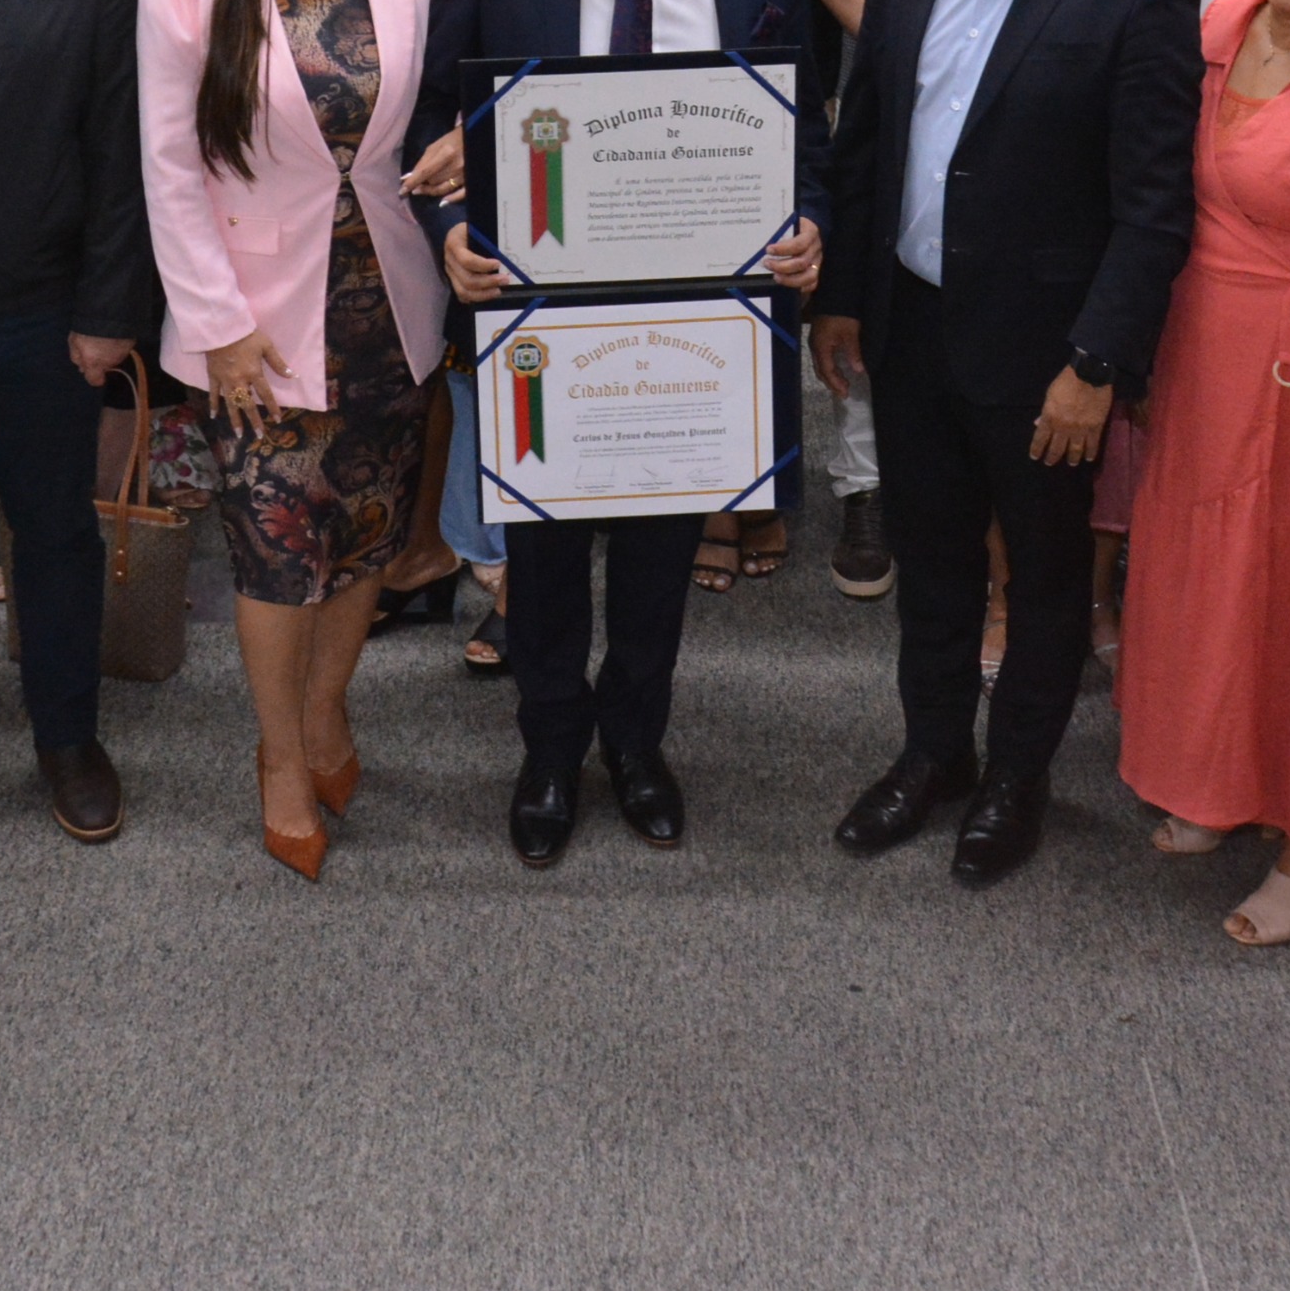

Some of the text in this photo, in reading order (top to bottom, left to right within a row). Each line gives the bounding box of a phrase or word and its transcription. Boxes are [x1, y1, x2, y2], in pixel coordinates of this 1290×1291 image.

[583, 99, 764, 138] Diploma Honorífico
[666, 128, 681, 138] de
[593, 145, 754, 163] Cidadania Goianiense
[571, 330, 726, 371] Diploma Honorífico
[636, 359, 650, 370] de
[568, 380, 720, 399] Cidadão Goianiense
[573, 434, 601, 442] Carlos
[615, 432, 641, 442] Jesus
[689, 427, 726, 437] Pimentel
